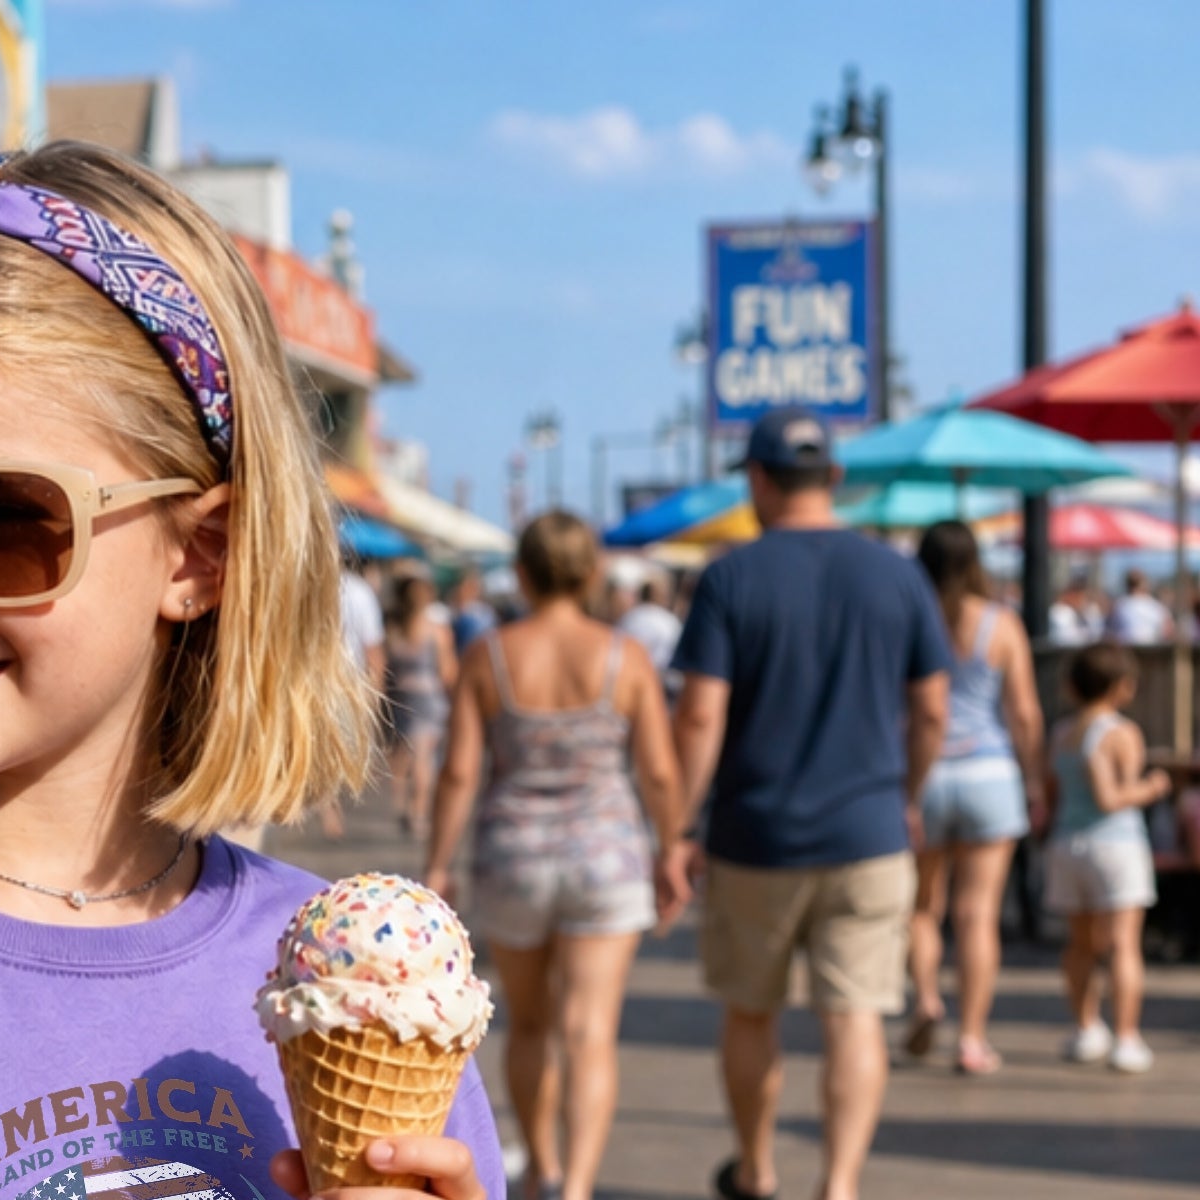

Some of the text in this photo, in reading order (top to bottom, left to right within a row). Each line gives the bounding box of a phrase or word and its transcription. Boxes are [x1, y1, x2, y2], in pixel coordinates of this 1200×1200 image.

[732, 281, 852, 345] FUN
[715, 344, 865, 407] GAMES
[62, 1136, 95, 1158] OF
[104, 1128, 155, 1150] THE
[164, 1128, 229, 1153] FREE
